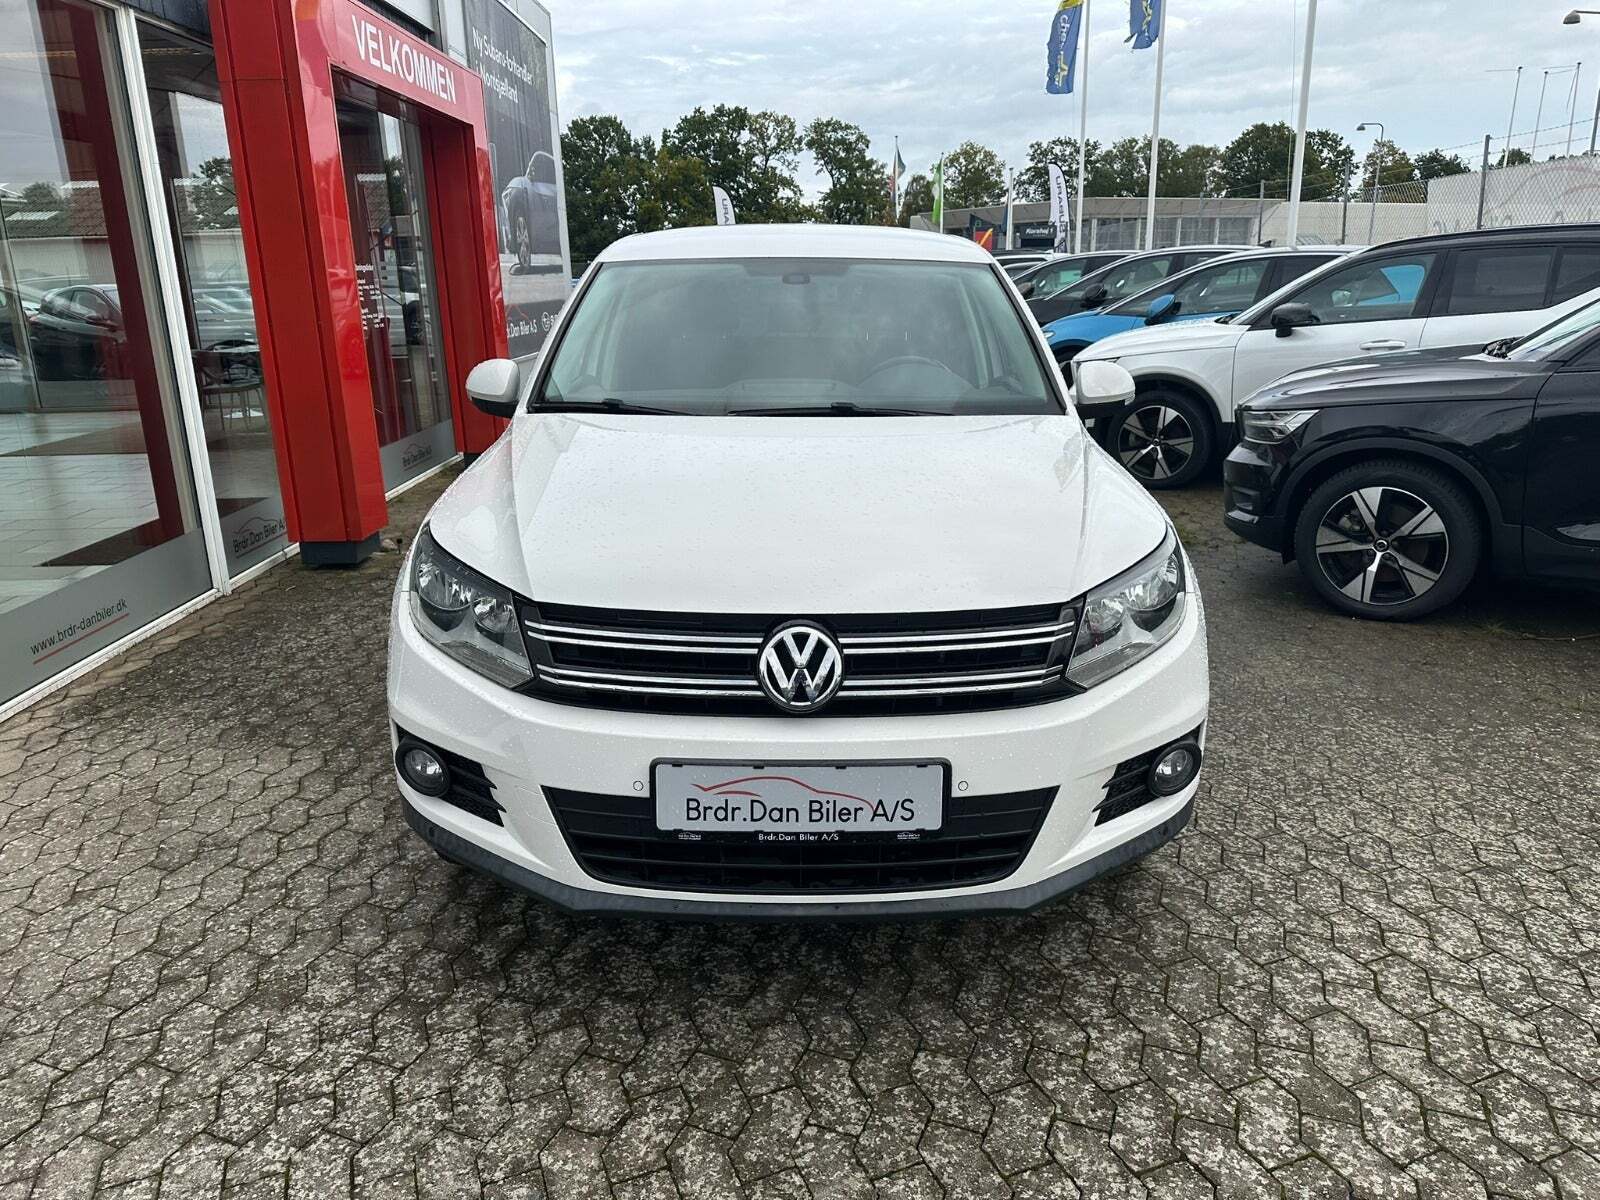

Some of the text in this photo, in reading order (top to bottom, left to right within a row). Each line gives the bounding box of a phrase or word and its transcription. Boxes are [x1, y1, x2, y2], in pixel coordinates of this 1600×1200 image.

[472, 26, 483, 57] Ny
[352, 14, 457, 104] VELKOMMEN
[30, 598, 128, 656] www.brdr-danbiler.dk
[686, 798, 915, 823] Brdr.Dan Biler A/S
[758, 833, 839, 841] Brdr.Dan Biler A/S
